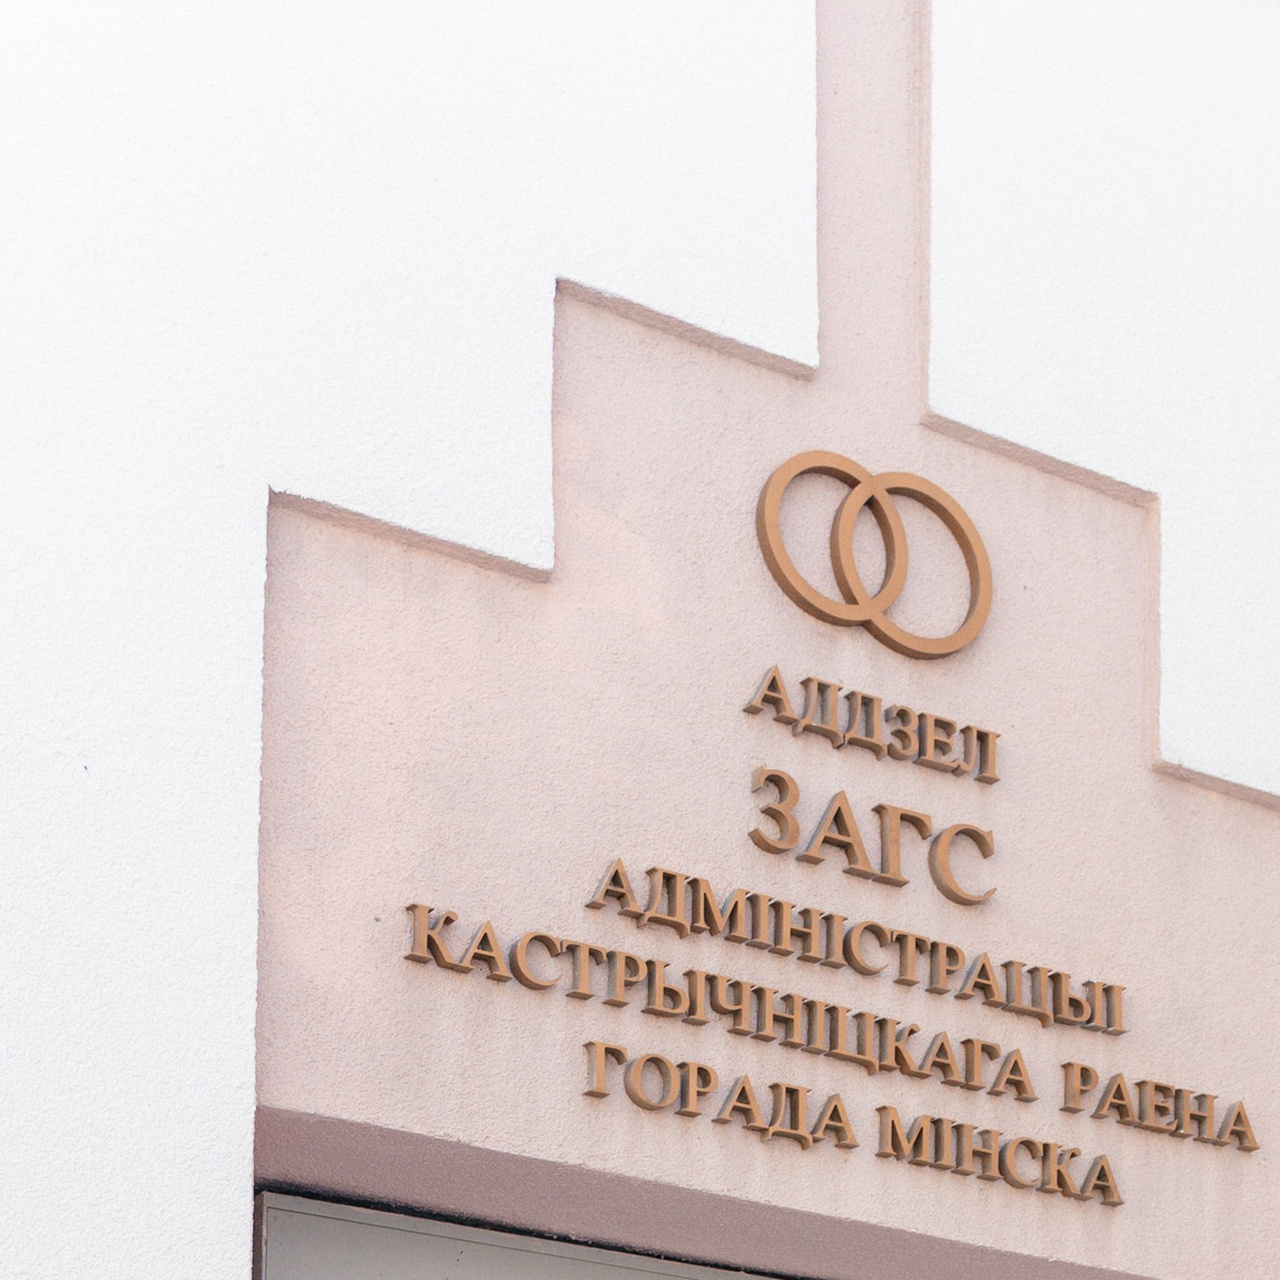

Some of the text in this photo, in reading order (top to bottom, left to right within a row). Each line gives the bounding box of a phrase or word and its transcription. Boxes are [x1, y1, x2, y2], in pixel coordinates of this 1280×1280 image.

[743, 664, 1001, 785] АДДЗЕЛ
[748, 766, 998, 906] ЗАГС
[403, 903, 1260, 1152] КАСТРЫЧНІЦКАГА РАЕНА
[585, 857, 1130, 1036] АДМІНІСТРАЦЫІ
[582, 1041, 1125, 1207] ГОРАДА МІНСКА
